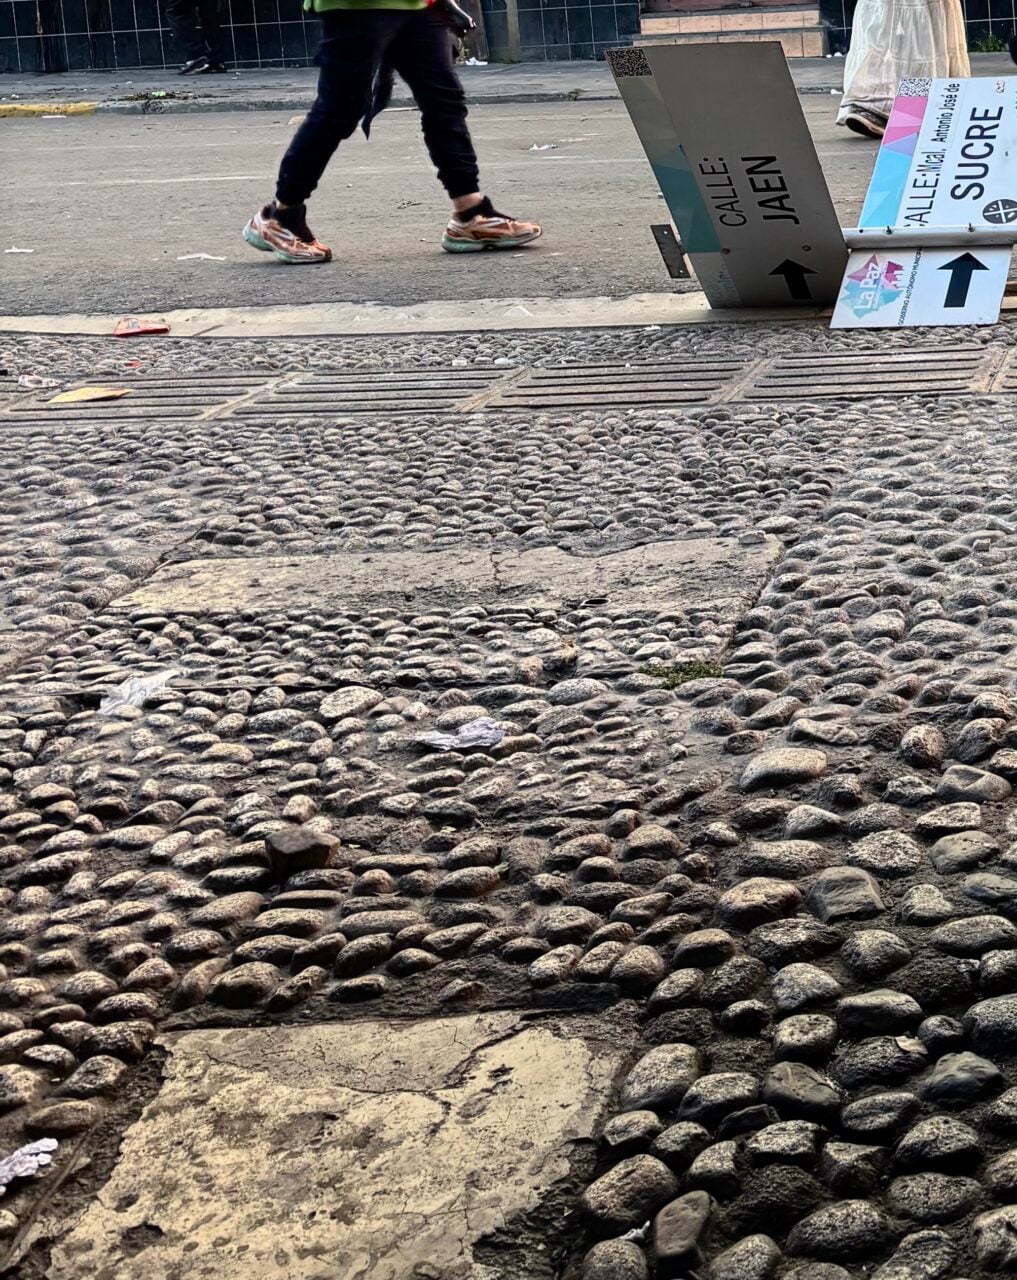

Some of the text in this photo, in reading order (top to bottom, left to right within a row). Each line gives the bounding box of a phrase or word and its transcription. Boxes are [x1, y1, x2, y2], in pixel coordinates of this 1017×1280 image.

[939, 93, 958, 111] José
[944, 83, 961, 93] de
[930, 112, 953, 143] Antonio
[950, 106, 1004, 201] SUCRE
[698, 156, 748, 227] CALLE:
[741, 155, 800, 225] JAEN
[859, 261, 880, 288] Paz
[853, 290, 875, 309] La
